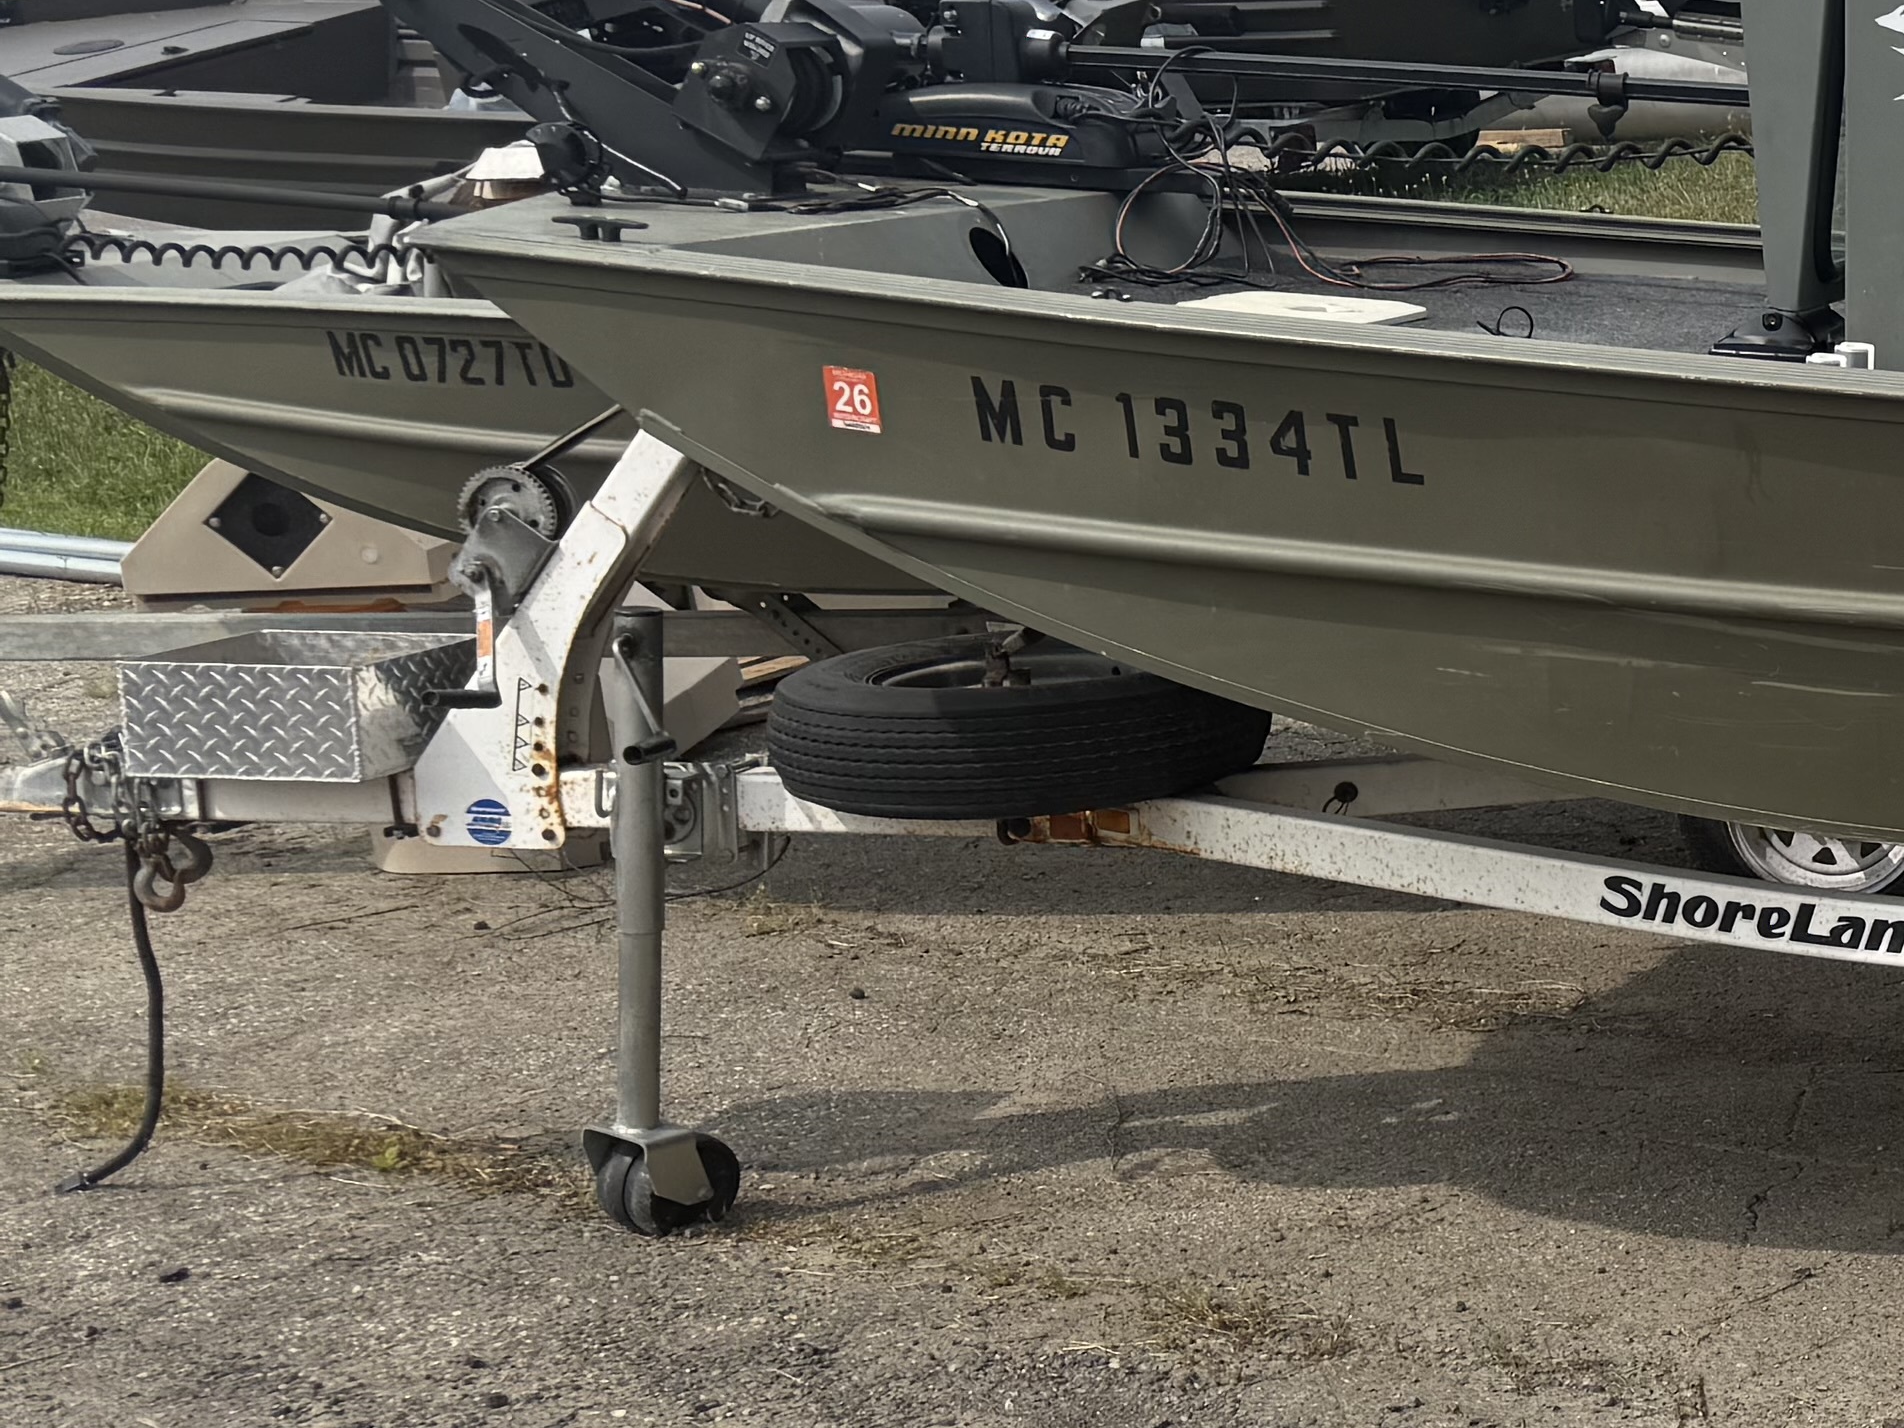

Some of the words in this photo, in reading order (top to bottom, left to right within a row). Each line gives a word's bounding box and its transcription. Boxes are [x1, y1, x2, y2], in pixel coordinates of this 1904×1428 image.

[983, 129, 1070, 147] KOTA
[327, 330, 391, 380] MC
[833, 381, 872, 416] 26
[971, 376, 1076, 452] MC
[1115, 392, 1425, 486] 1334TL
